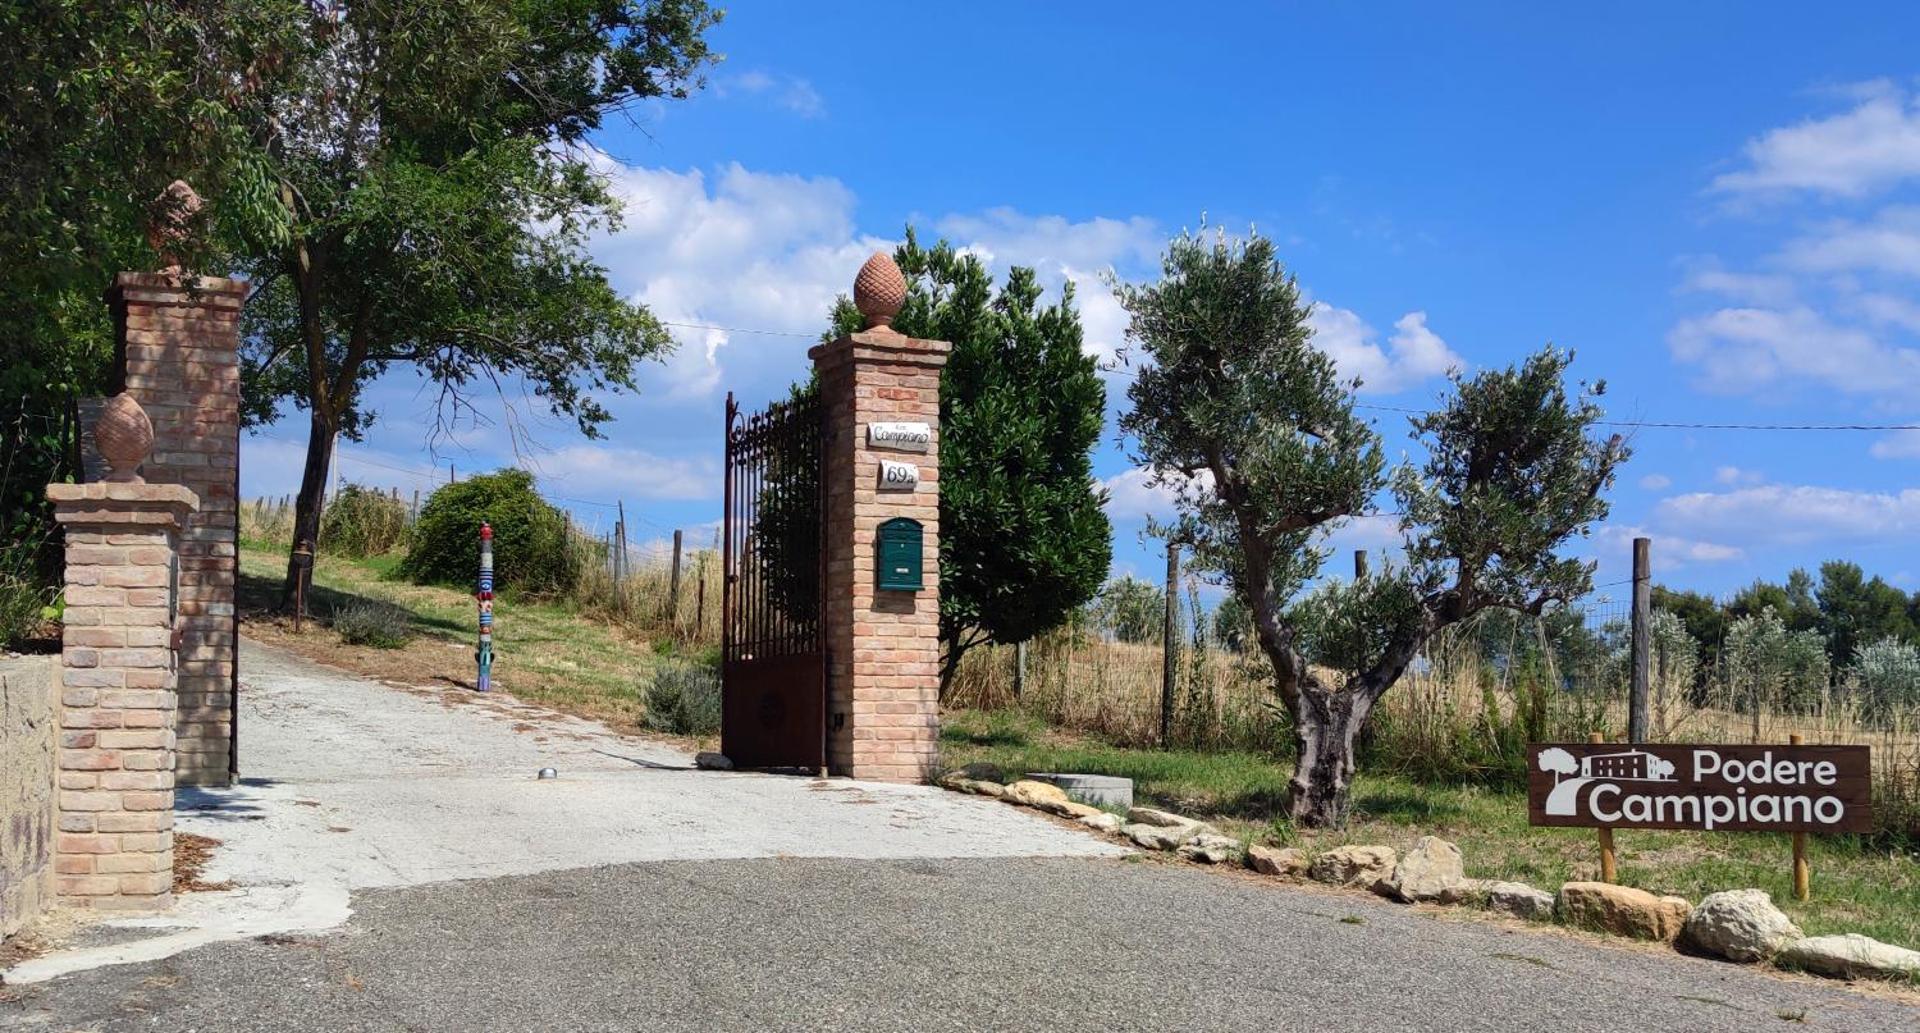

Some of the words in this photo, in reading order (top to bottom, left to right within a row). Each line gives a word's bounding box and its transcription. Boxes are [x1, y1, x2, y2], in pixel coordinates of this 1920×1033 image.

[874, 426, 928, 446] Campiano
[887, 466, 914, 484] 69a
[1693, 750, 1837, 785] Podere
[1589, 784, 1844, 830] Campiano
